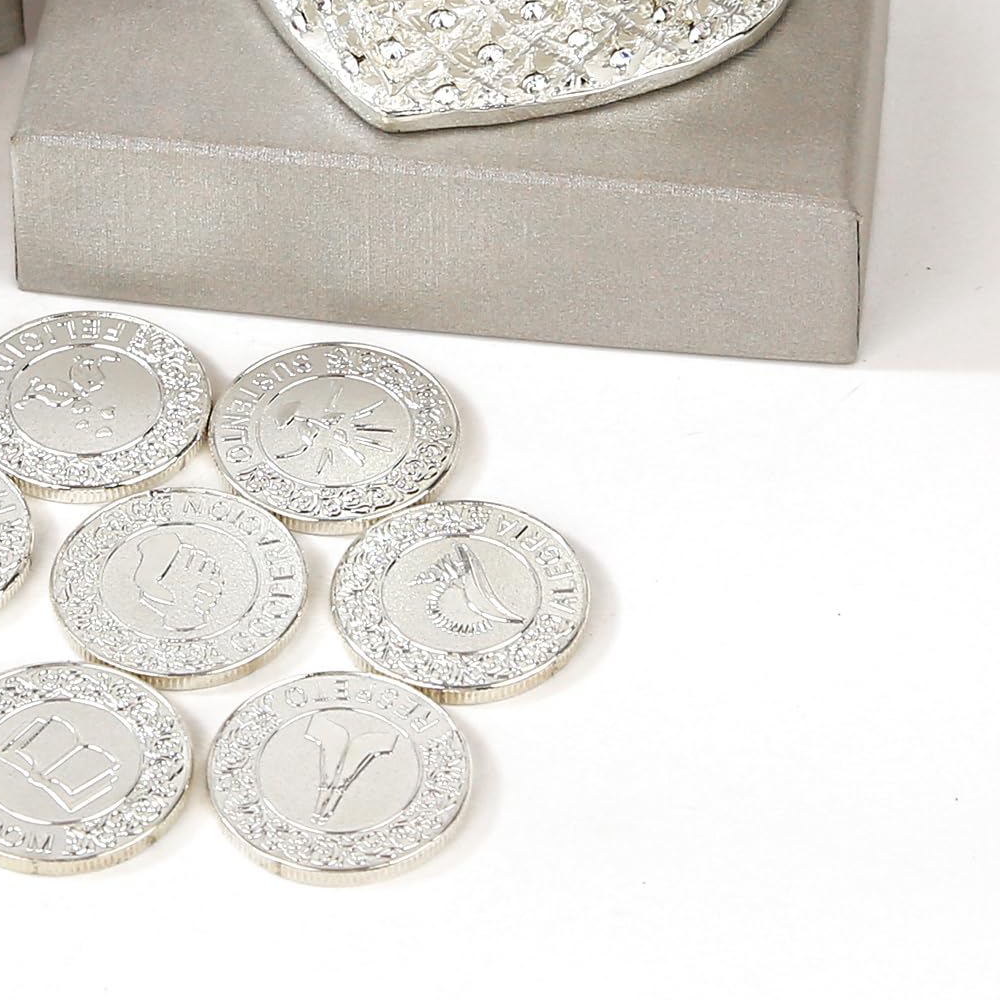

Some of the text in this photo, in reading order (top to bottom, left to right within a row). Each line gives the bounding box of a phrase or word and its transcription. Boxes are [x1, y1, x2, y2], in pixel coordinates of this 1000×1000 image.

[220, 353, 313, 463] SUSTENTO
[182, 500, 297, 652] COOPERACION
[497, 513, 579, 615] ALEGRIA
[284, 679, 439, 734] RESPETO
